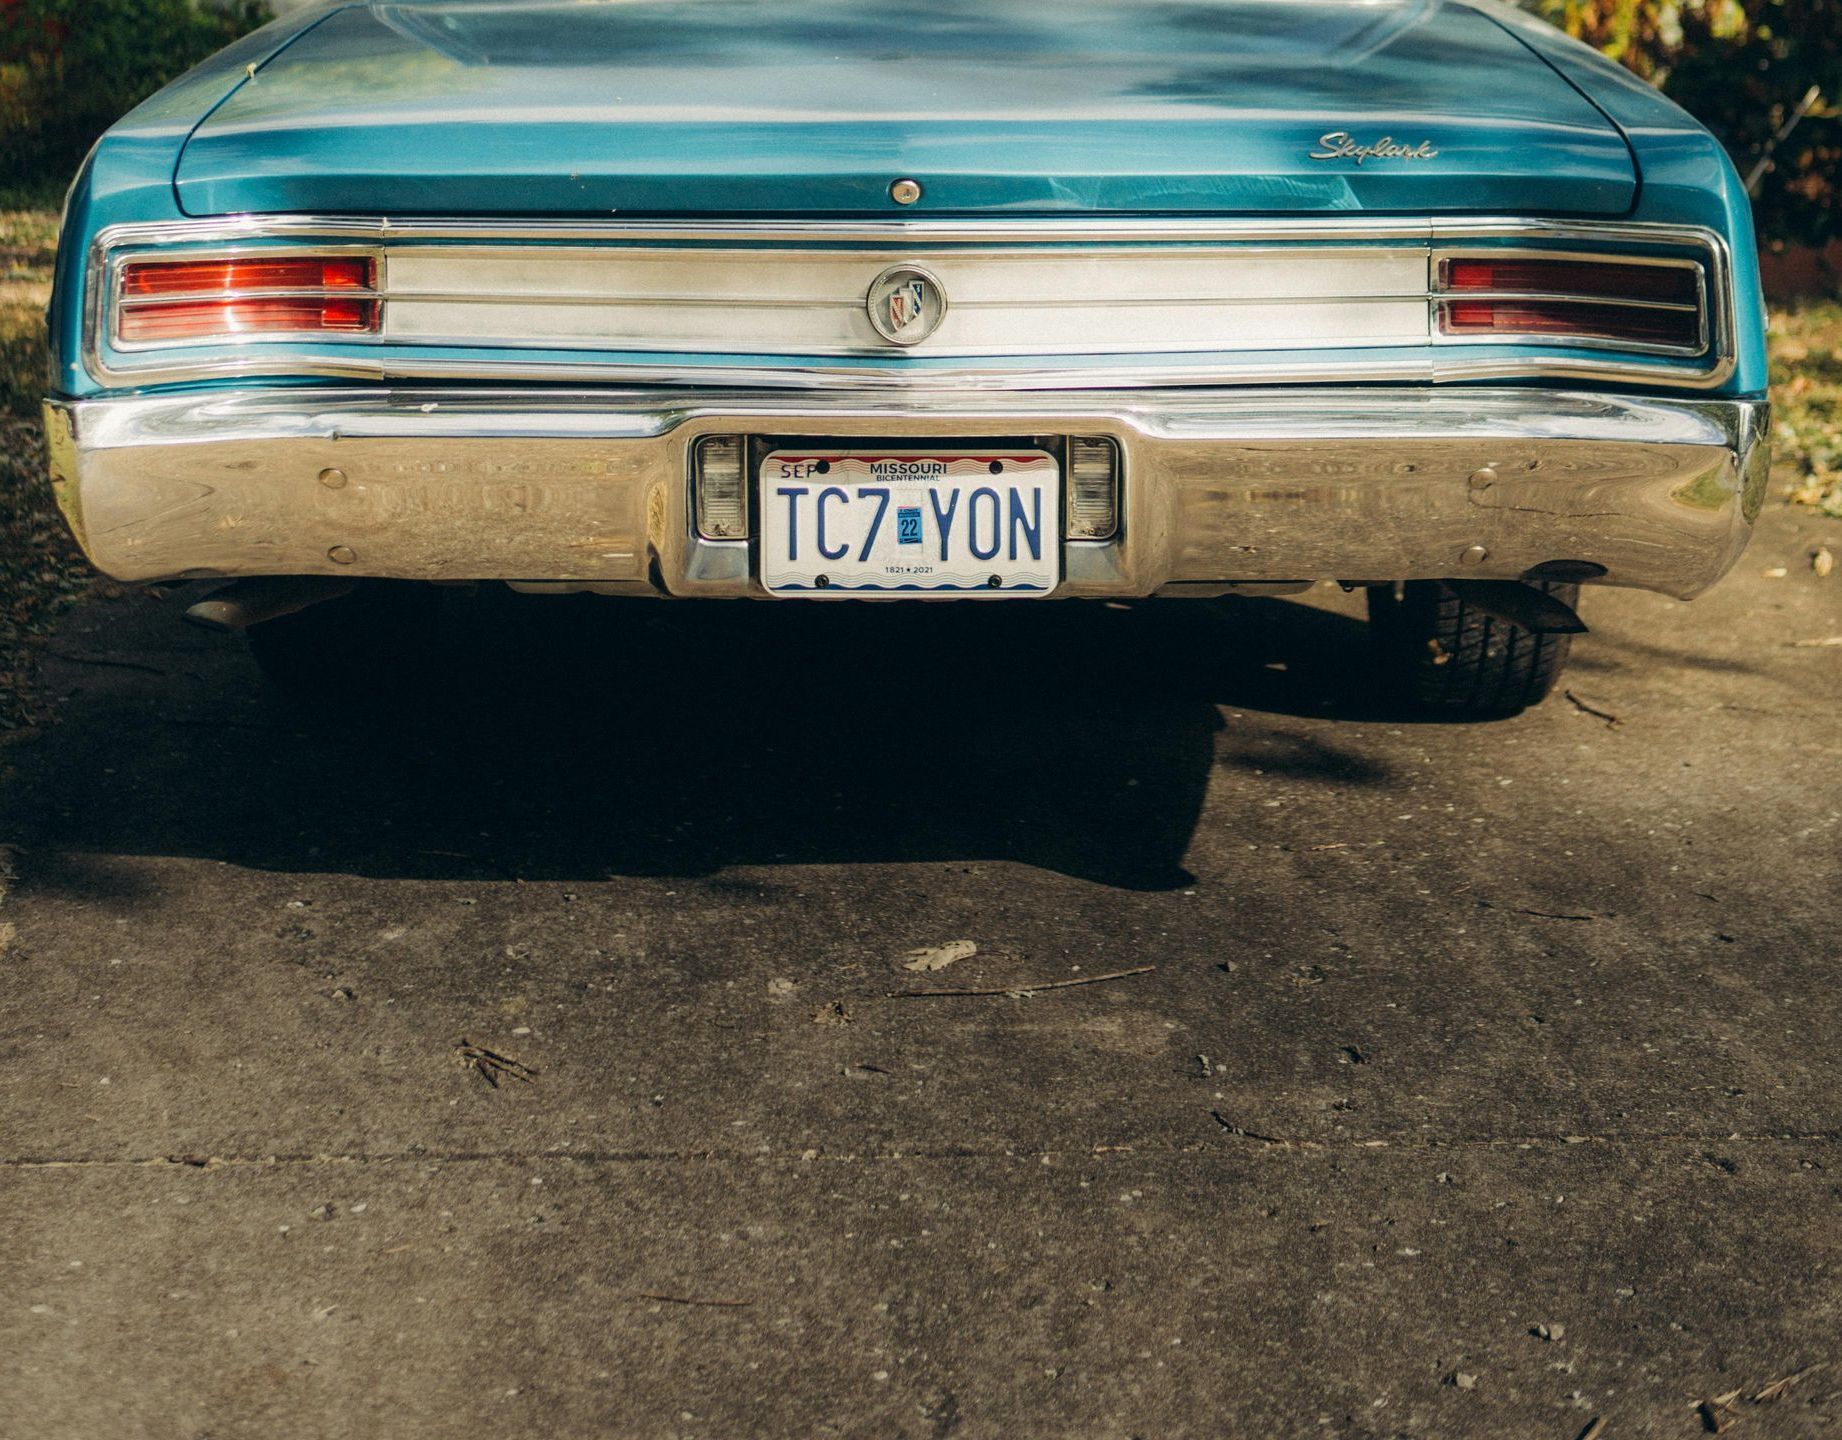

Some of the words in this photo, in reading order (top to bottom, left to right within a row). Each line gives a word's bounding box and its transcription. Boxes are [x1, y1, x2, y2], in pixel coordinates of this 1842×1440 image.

[1309, 131, 1438, 165] Skylark
[781, 464, 817, 478] SEP
[870, 463, 947, 474] MISSOURI
[876, 474, 941, 482] BICENTENNIAL
[777, 487, 891, 562] TC7
[929, 487, 1041, 561] YON
[901, 518, 918, 537] 22
[885, 566, 904, 574] 1821
[913, 566, 933, 574] 2021
